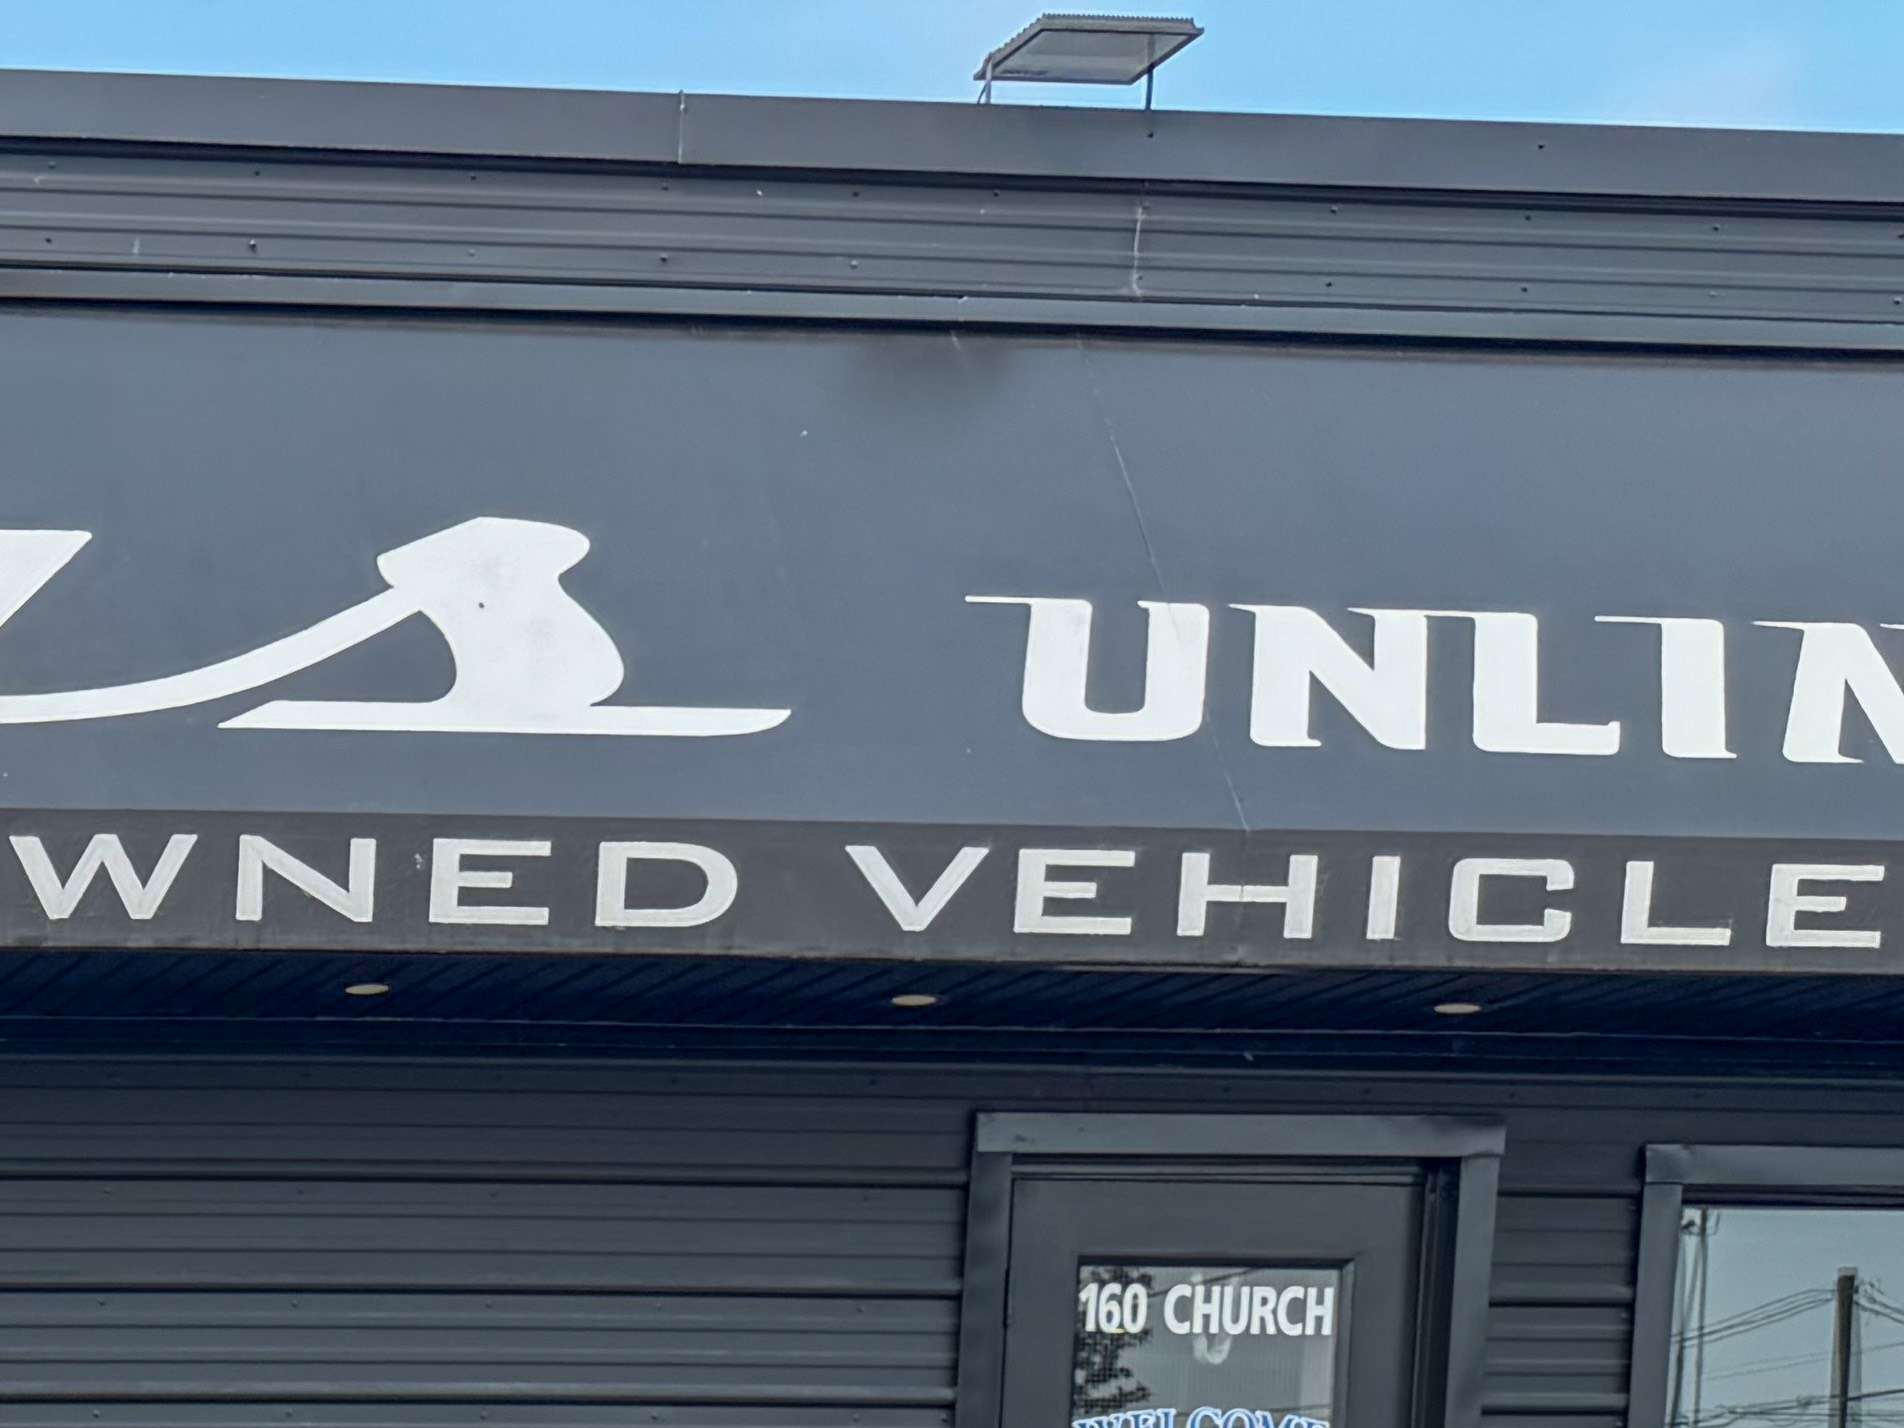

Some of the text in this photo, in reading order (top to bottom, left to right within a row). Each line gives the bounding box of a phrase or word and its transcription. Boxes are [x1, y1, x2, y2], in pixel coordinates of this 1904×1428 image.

[845, 846, 1884, 948] VEHICLE
[1079, 1283, 1334, 1336] 160 CHURCH
